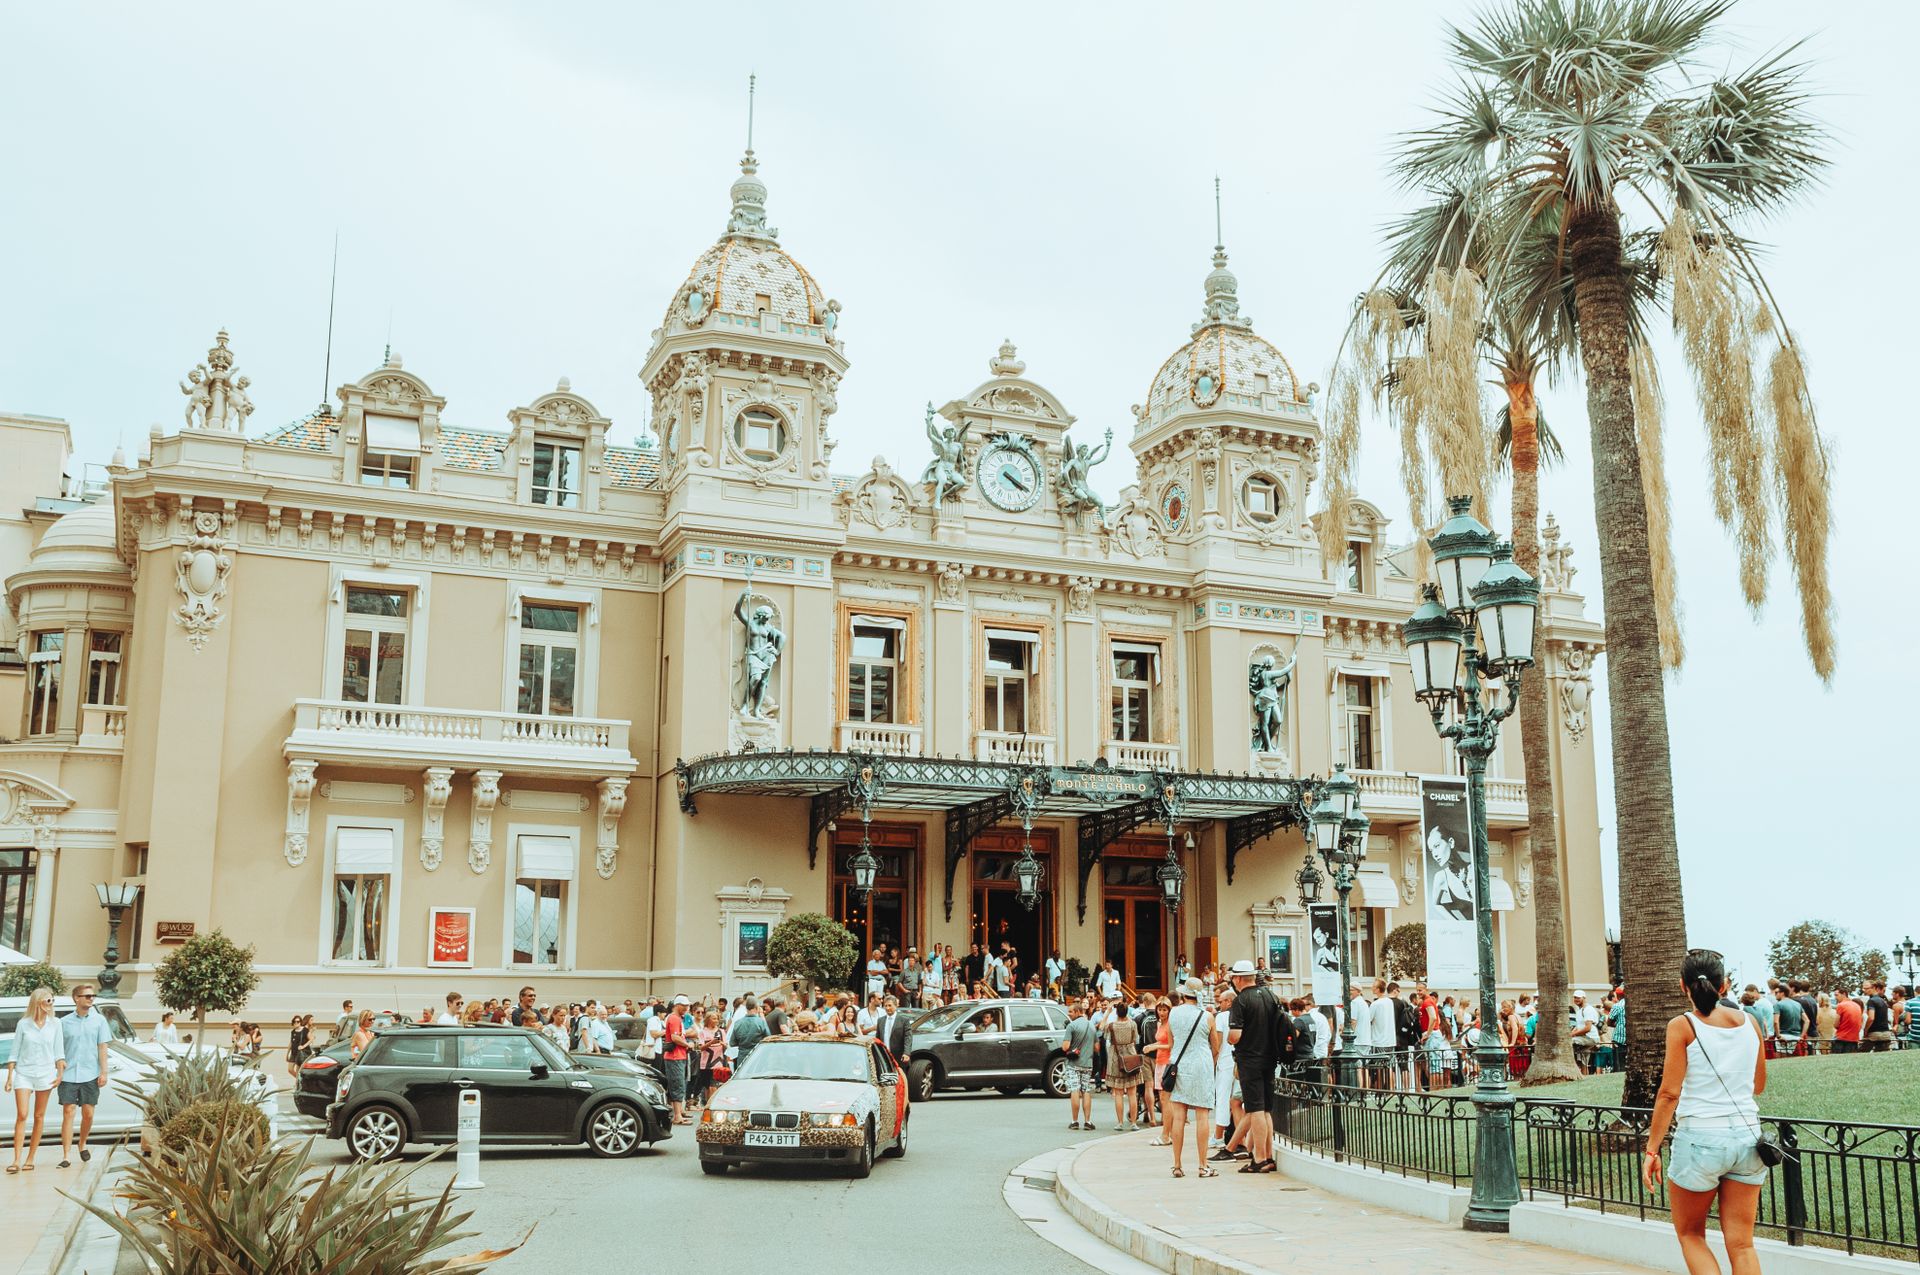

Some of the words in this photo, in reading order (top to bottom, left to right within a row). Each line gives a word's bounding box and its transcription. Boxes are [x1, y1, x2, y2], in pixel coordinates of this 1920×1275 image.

[1081, 774, 1122, 783] CASINO
[1429, 792, 1460, 802] CHANEL
[749, 1134, 774, 1144] P424
[776, 1135, 796, 1145] BTT
